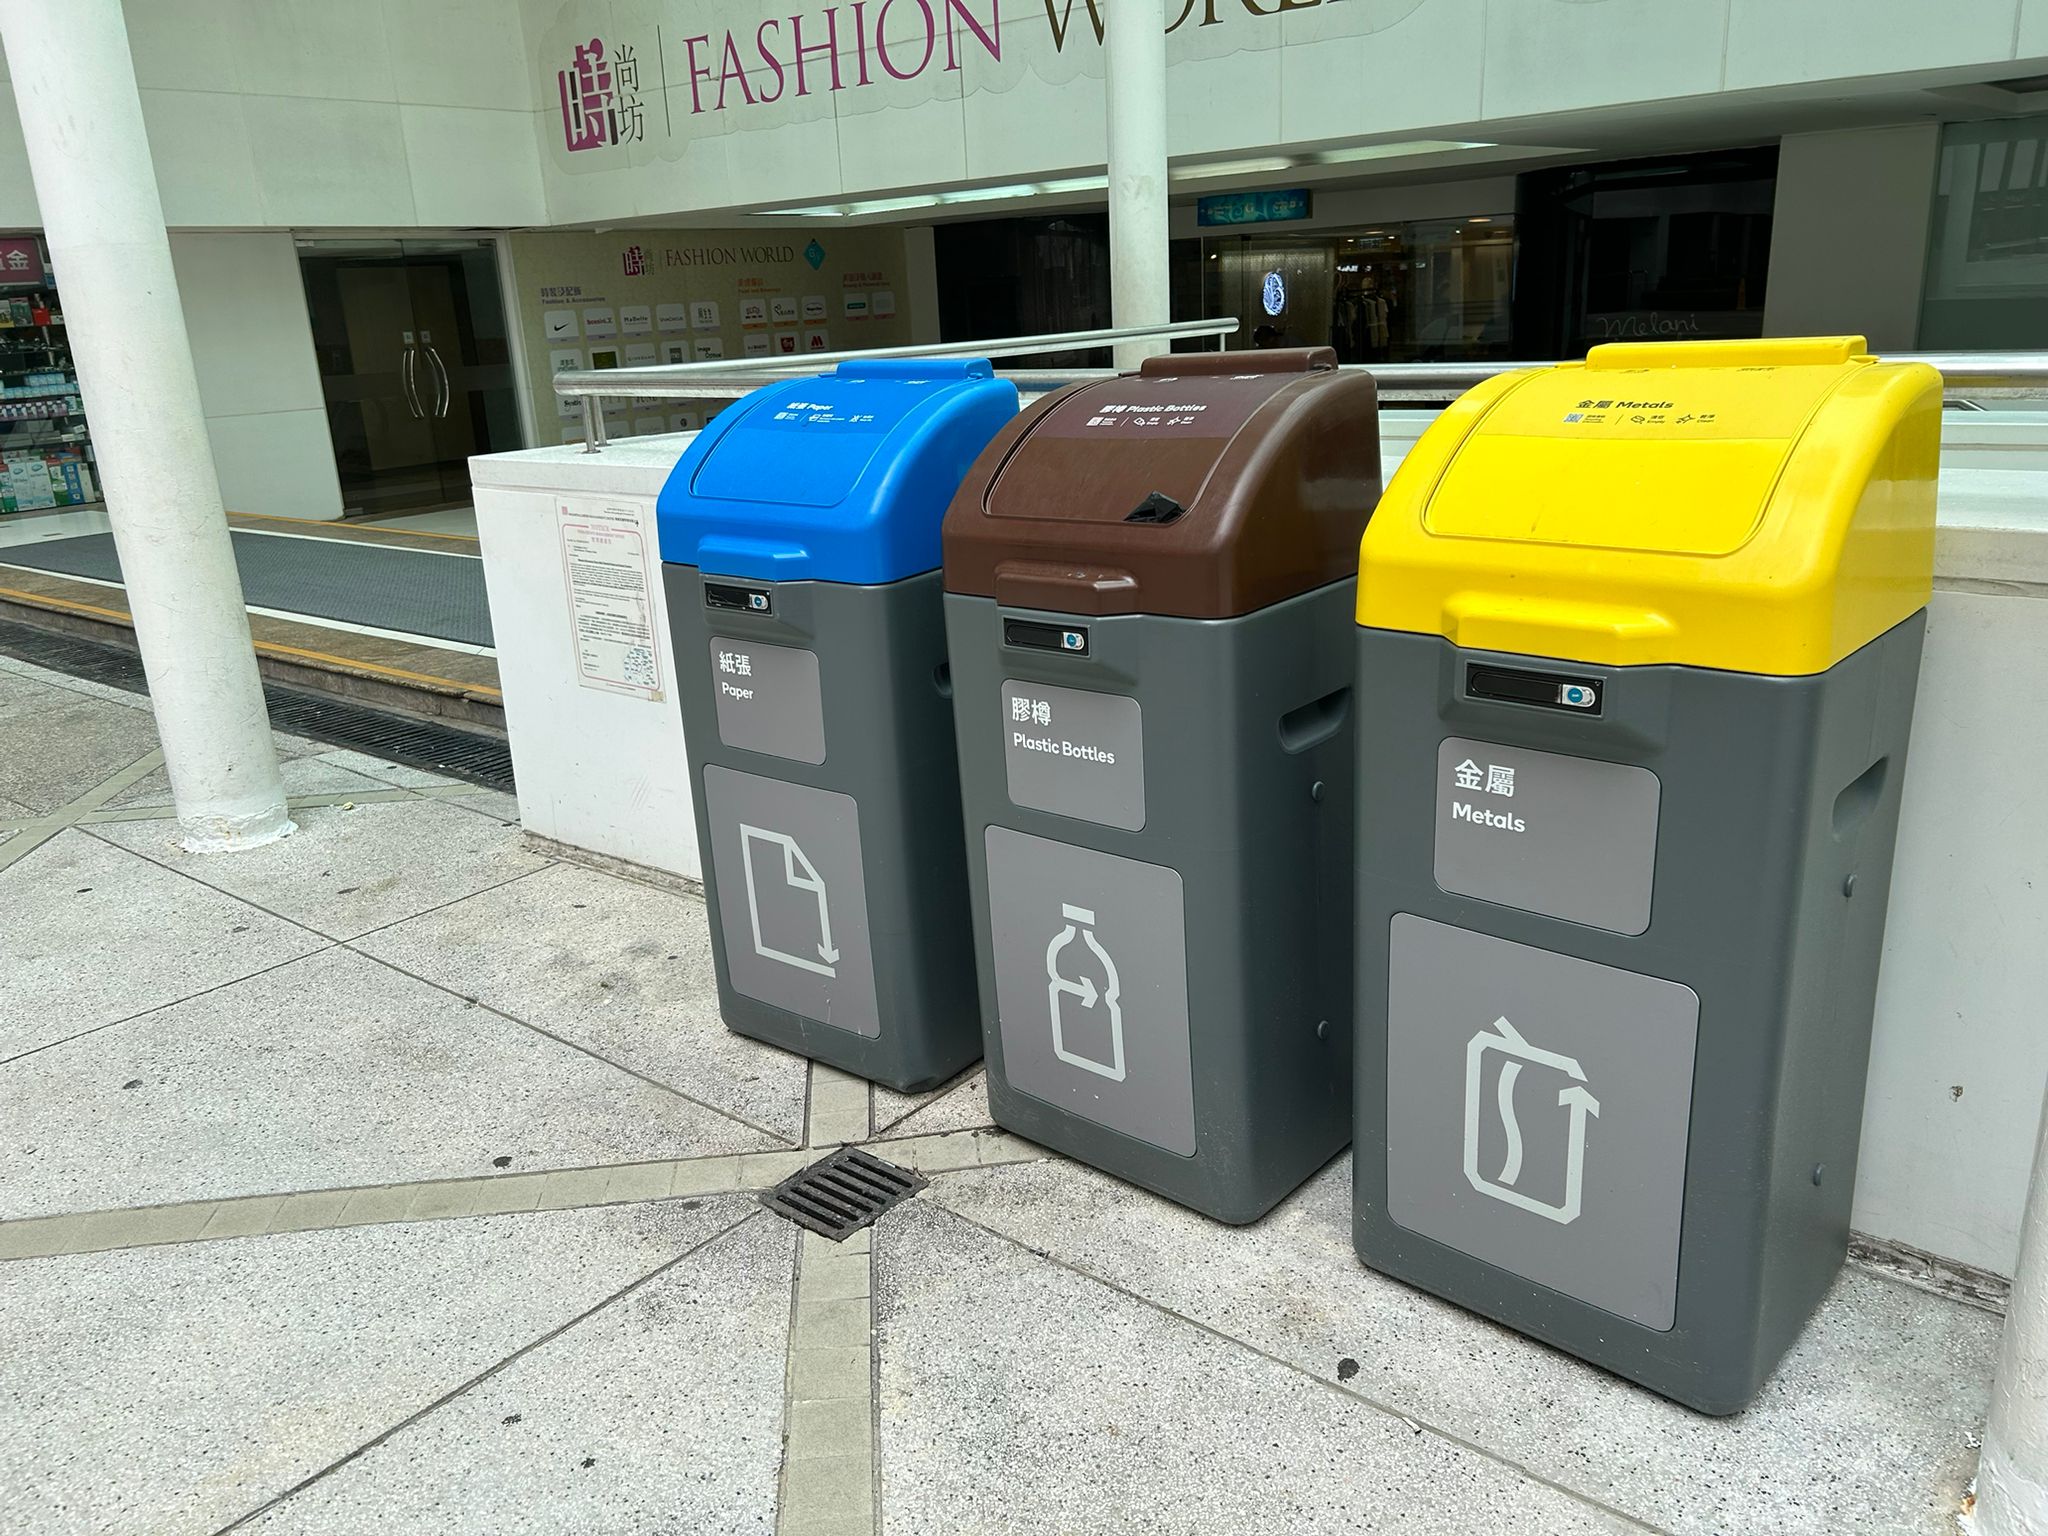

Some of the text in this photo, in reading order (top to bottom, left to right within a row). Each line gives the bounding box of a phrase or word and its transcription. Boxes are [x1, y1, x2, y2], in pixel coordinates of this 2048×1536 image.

[682, 0, 1001, 115] FASHION
[0, 249, 30, 271] 金
[665, 247, 736, 267] FASHION
[739, 245, 794, 264] WORLD
[807, 403, 834, 411] Paper
[1126, 405, 1165, 413] Plastic
[1163, 404, 1207, 412] Bottles
[1615, 401, 1674, 409] Metals
[718, 651, 752, 677] 紙張
[721, 682, 754, 700] Paper
[1011, 697, 1052, 726] 膠樽
[1013, 732, 1115, 764] Plastic Bottles
[1454, 758, 1516, 798] 金屬
[1452, 801, 1526, 833] Metals
